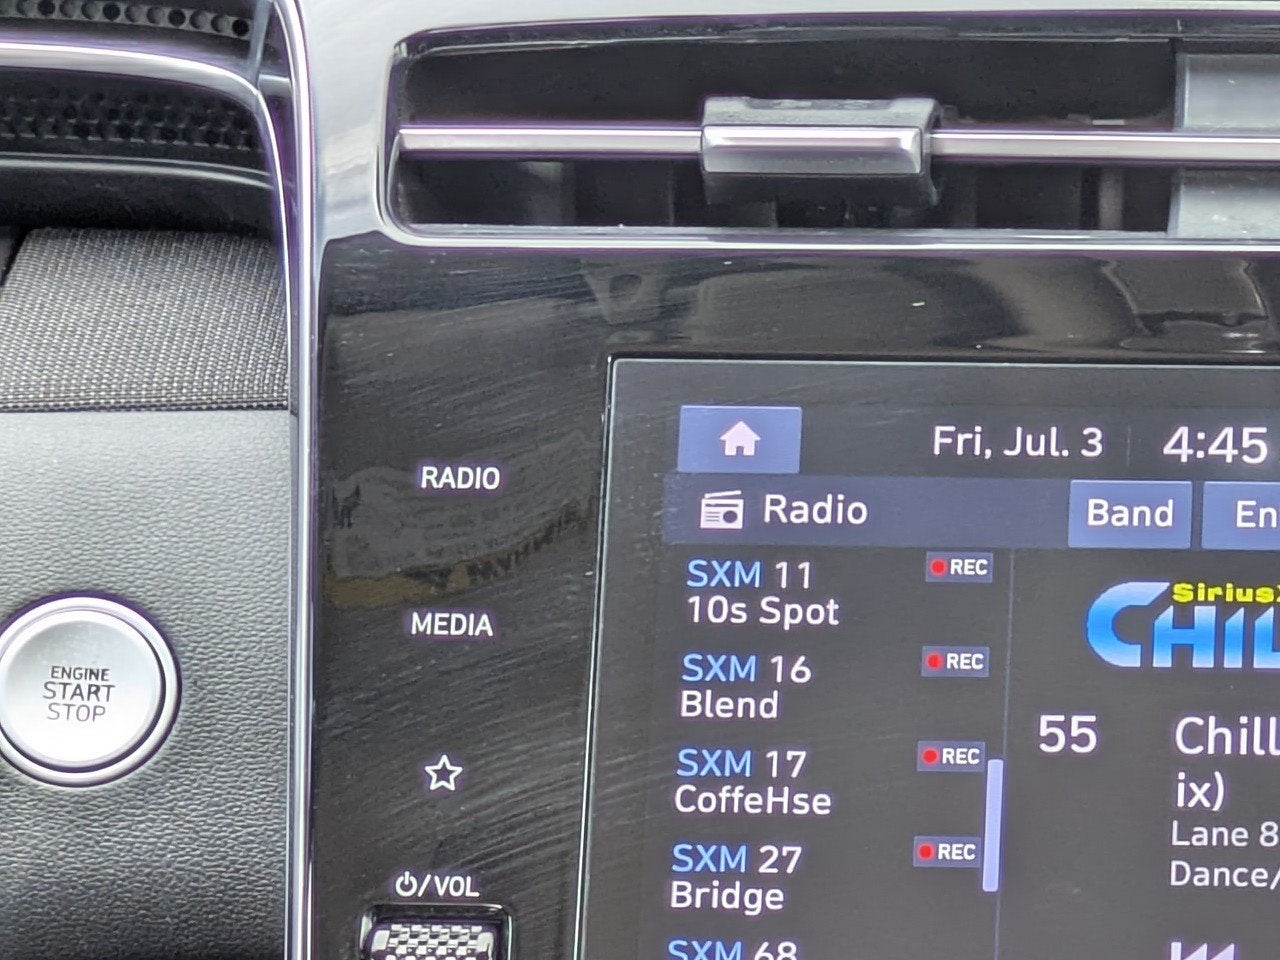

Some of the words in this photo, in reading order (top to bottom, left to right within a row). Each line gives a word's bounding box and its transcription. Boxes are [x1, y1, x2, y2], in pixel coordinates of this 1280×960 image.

[933, 425, 992, 460] Fri,
[1003, 426, 1069, 457] Jul.
[1080, 427, 1103, 457] 3
[1162, 426, 1268, 464] 4:45
[420, 465, 500, 490] RADIO
[764, 493, 868, 525] Radio
[1087, 498, 1174, 527] Band
[686, 558, 761, 588] SXM
[775, 561, 810, 589] 11
[950, 558, 988, 576] REC
[411, 611, 494, 637] MEDIA
[688, 594, 748, 624] 10s
[759, 595, 840, 631] Spot
[51, 665, 109, 680] ENGINE
[681, 653, 757, 682] SXM
[770, 655, 812, 684] 16
[946, 652, 984, 670] REC
[43, 681, 115, 702] START
[680, 689, 779, 719] Blend
[47, 703, 106, 722] STOP
[1039, 714, 1097, 754] 55
[676, 748, 752, 778] SXM
[766, 750, 807, 778] 17
[942, 747, 980, 765] REC
[674, 784, 832, 815] CoffeHse
[1177, 770, 1225, 812] ix)
[1171, 819, 1249, 847] Lane
[1259, 821, 1279, 847] 8
[671, 843, 747, 873] SXM
[758, 844, 802, 874] 27
[937, 843, 976, 860] REC
[670, 879, 784, 916] Bridge
